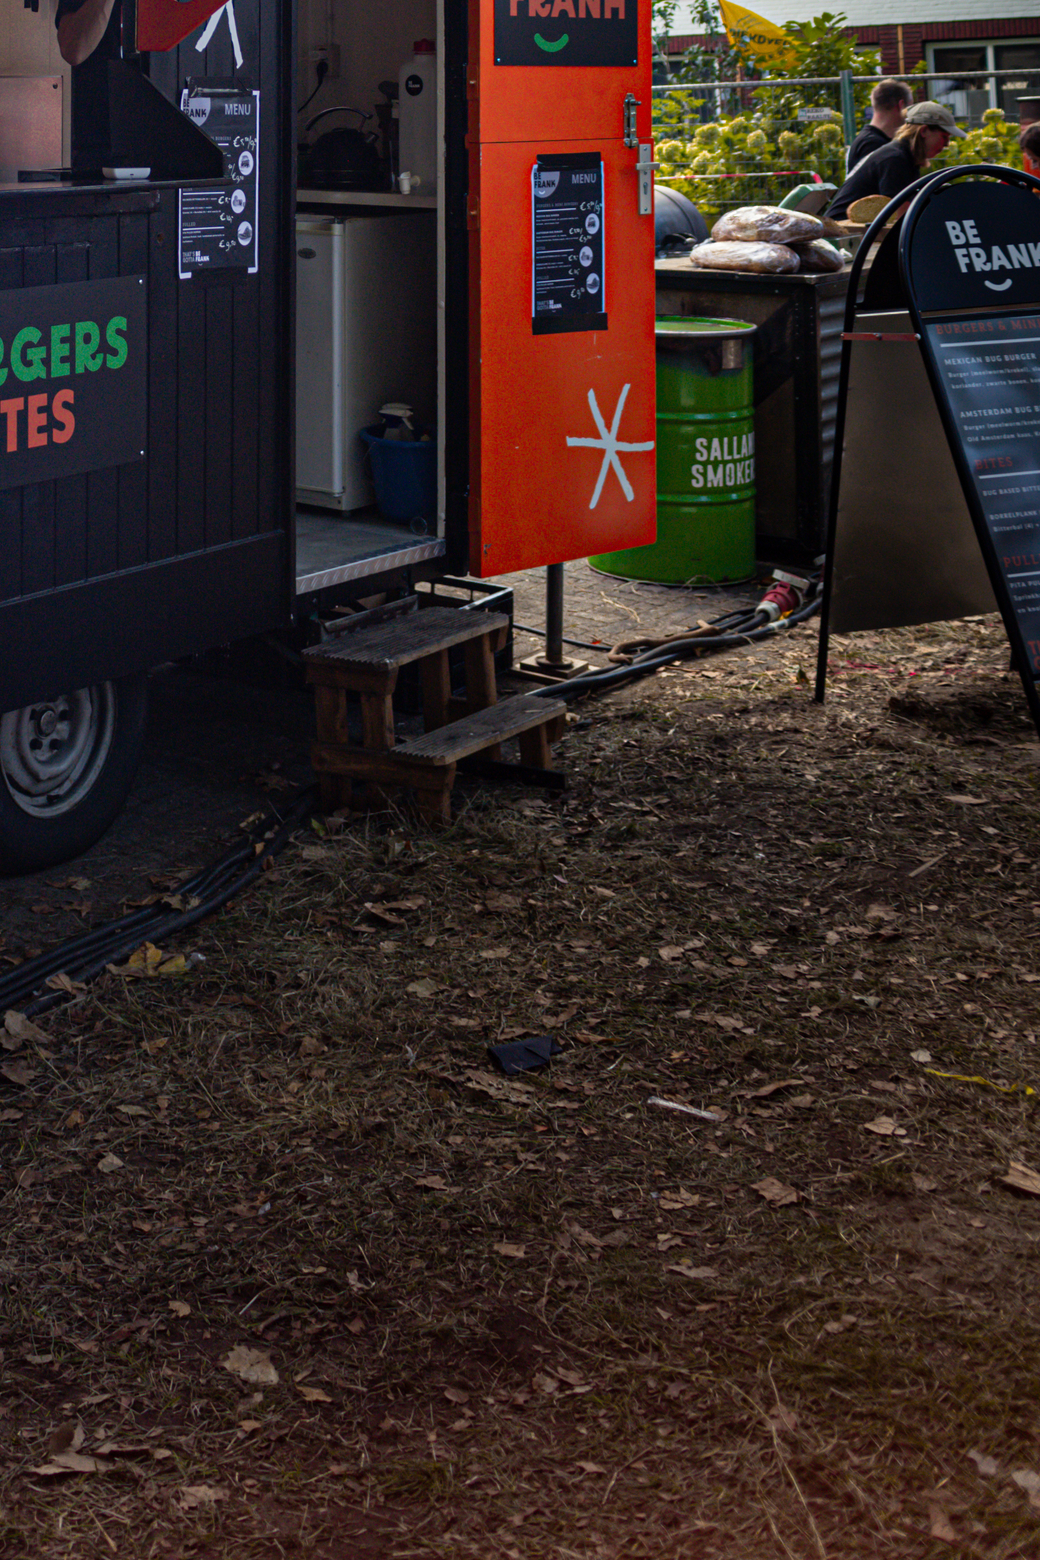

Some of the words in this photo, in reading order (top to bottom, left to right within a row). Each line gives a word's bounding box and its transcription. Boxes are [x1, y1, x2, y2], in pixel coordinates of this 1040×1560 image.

[225, 104, 251, 115] MENU
[534, 180, 555, 188] FRANK
[572, 173, 596, 184] MENU
[945, 220, 981, 245] BE
[935, 320, 994, 335] BURGERS
[999, 321, 1006, 331] &
[944, 356, 983, 366] MEXICAN
[985, 355, 1002, 363] BUG
[1004, 352, 1037, 361] BURGER
[960, 407, 1013, 418] AMSTERDAM
[1015, 406, 1032, 414] BUG
[974, 457, 1013, 470] BITES
